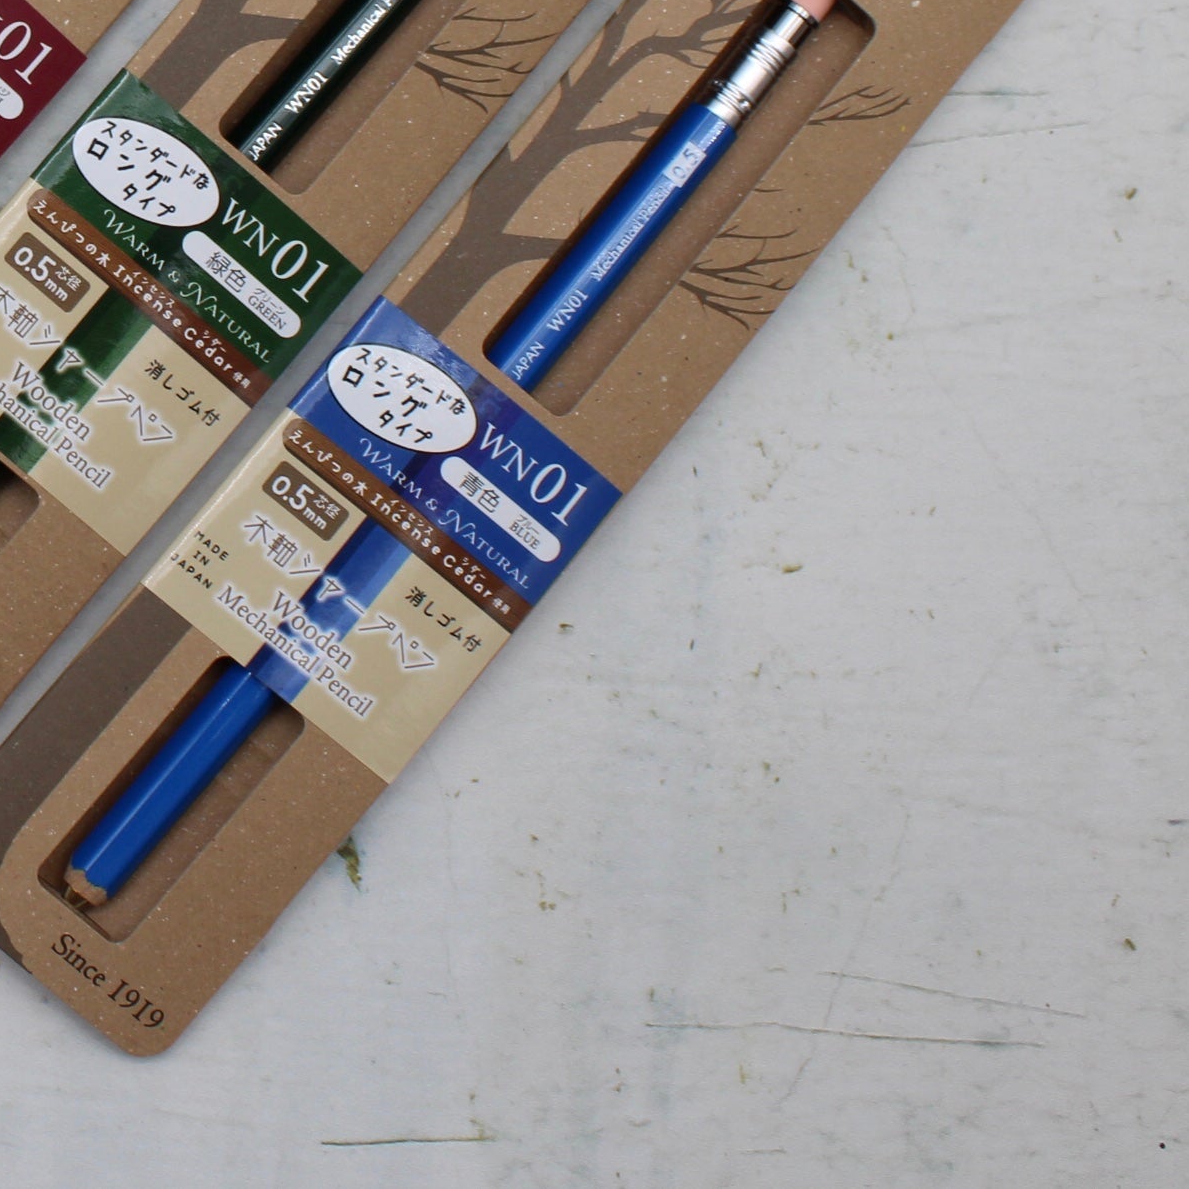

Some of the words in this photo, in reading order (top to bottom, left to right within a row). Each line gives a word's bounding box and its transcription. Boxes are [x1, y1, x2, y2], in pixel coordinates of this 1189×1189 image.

[246, 119, 284, 162] JAPAN
[282, 68, 329, 116] WN01
[329, 2, 387, 66] Mechanical
[85, 137, 172, 191] ロング
[100, 119, 209, 189] スタンダードな
[122, 183, 175, 217] タイプ
[103, 209, 167, 272] WARM
[166, 268, 179, 285] &
[179, 282, 269, 364] NATURAL
[220, 195, 330, 304] WN01
[111, 262, 184, 330] Incense
[184, 328, 232, 371] Cedar
[203, 250, 250, 294] 緑色
[245, 293, 287, 331] GREEN
[509, 338, 546, 381] JAPAN
[544, 286, 590, 334] WN01
[12, 360, 91, 442] Wooden
[143, 358, 221, 427] 消しゴム付
[341, 364, 427, 417] ロング
[355, 347, 464, 415] スタンダードな
[52, 435, 111, 489] Pencil
[378, 409, 432, 443] タイプ
[359, 438, 424, 500] WARM
[424, 496, 437, 513] &
[437, 510, 528, 590] NATURAL
[458, 475, 494, 513] 青色
[508, 521, 540, 550] BLUE
[479, 420, 588, 527] WN01
[169, 551, 214, 590] JAPAN
[191, 549, 211, 567] IN
[192, 529, 230, 562] MADE
[369, 491, 442, 557] Incense
[443, 555, 492, 598] Cedar
[242, 514, 435, 668] 木軸シャープペン
[272, 590, 353, 671] Wooden
[403, 585, 483, 653] 消しゴム付
[215, 584, 320, 674] Mechanical
[314, 664, 373, 717] Pencil
[51, 935, 104, 986] Since
[106, 977, 165, 1027] 1919
